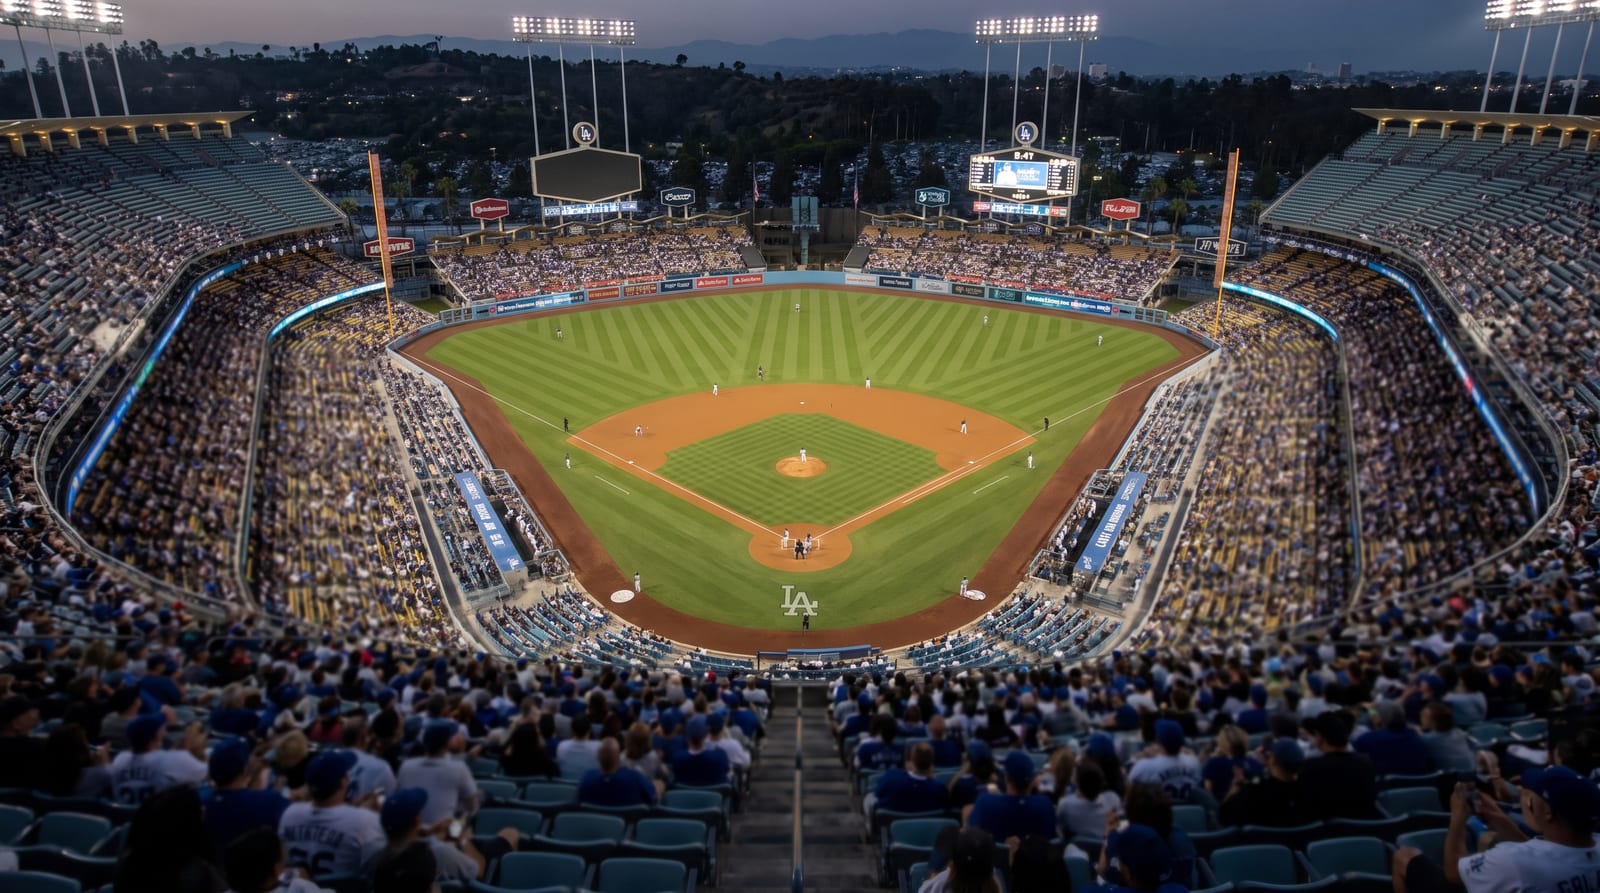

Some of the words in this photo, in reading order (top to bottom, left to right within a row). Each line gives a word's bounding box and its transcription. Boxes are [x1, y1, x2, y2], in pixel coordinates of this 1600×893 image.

[581, 126, 591, 140] LA
[1020, 125, 1030, 140] LA
[780, 585, 818, 616] LA
